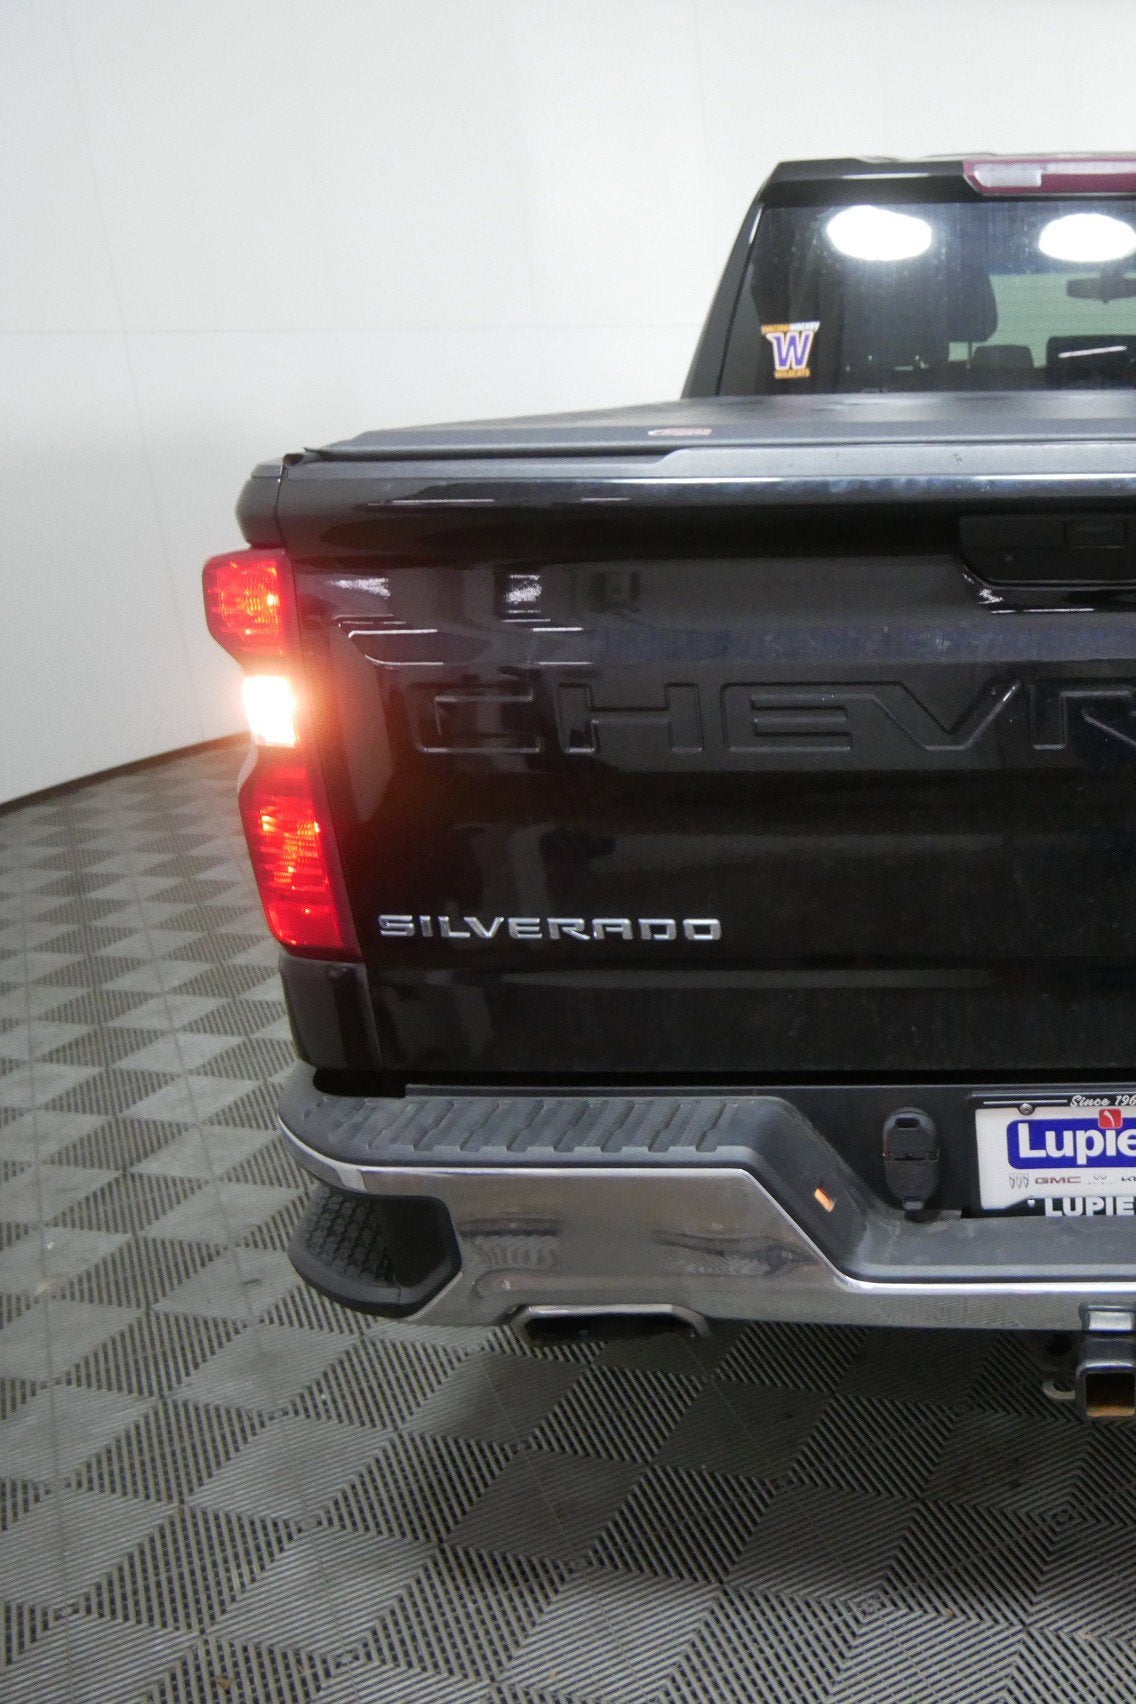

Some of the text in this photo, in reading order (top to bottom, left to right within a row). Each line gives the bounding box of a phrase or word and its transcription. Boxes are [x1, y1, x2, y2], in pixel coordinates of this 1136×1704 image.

[766, 331, 814, 369] W
[378, 914, 722, 941] SILVERADO
[1069, 1094, 1110, 1107] Since
[1035, 1175, 1081, 1184] GMC
